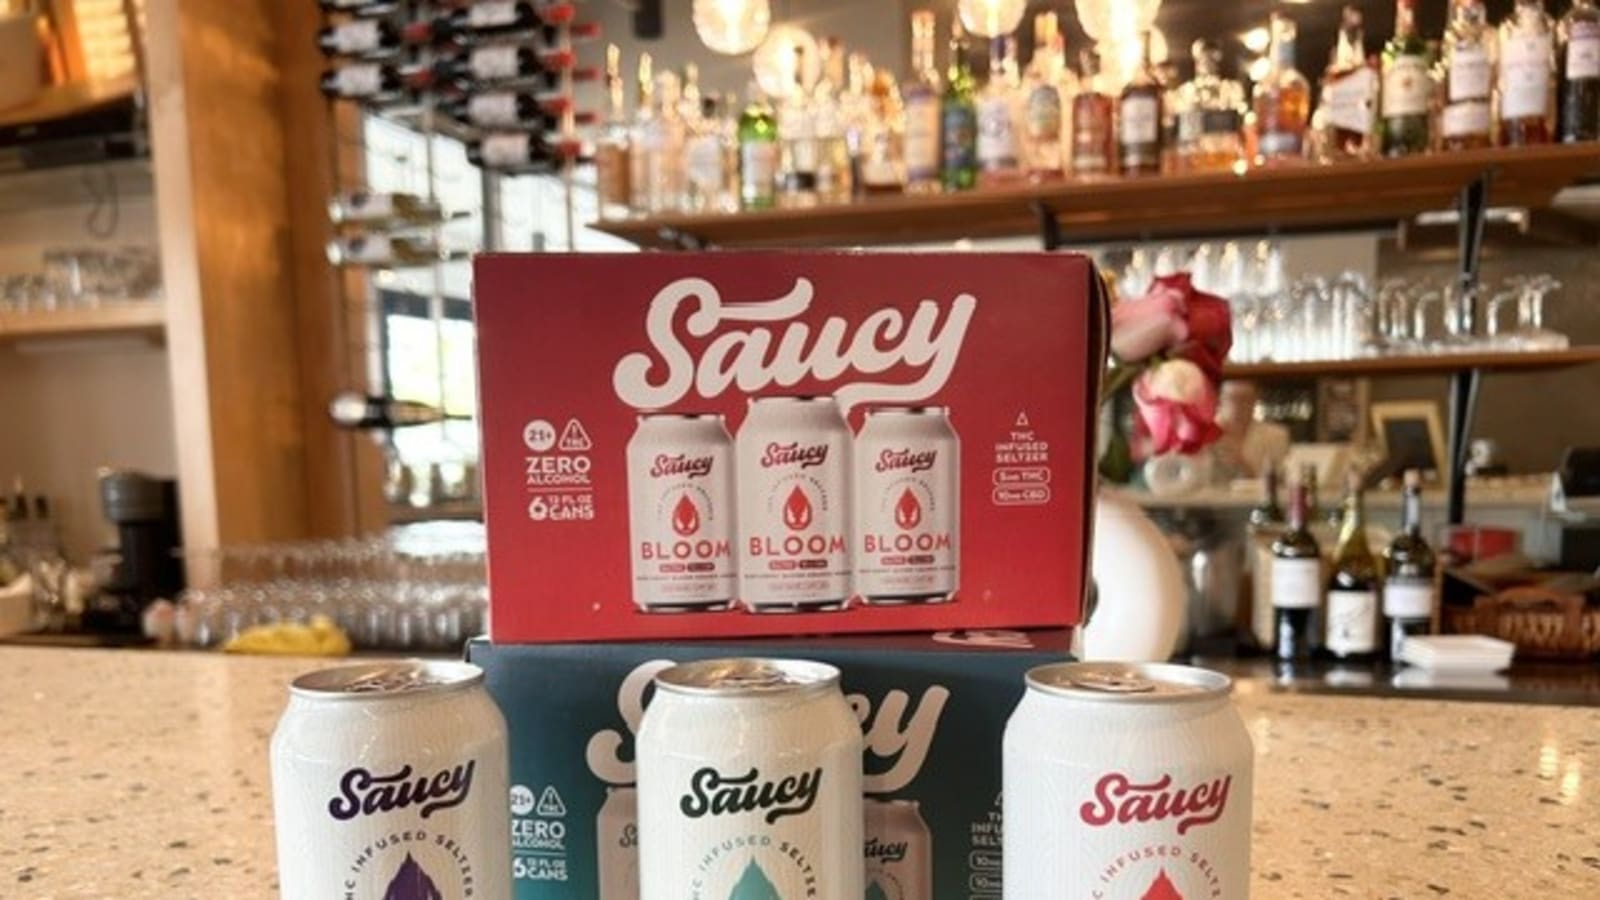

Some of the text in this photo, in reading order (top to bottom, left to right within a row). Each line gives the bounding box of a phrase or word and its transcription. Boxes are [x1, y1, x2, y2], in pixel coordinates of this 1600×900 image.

[613, 277, 977, 414] Saucy
[528, 429, 552, 441] 21+
[1010, 432, 1035, 440] THC
[759, 441, 829, 469] Saucy
[994, 441, 1048, 451] INFUSED
[525, 456, 591, 473] ZERO
[651, 453, 714, 479] Saucy
[875, 448, 938, 473] Saucy
[995, 452, 1048, 462] SELTZER
[526, 474, 591, 484] ALCOHOL
[528, 496, 548, 520] 6
[549, 504, 594, 520] CANS
[641, 541, 731, 560] BLOOM
[748, 534, 845, 556] BLOOM
[864, 533, 951, 553] BLOOM
[329, 759, 475, 820] Saucy
[680, 766, 823, 825] Saucy
[1080, 773, 1232, 835] Saucy
[511, 819, 566, 839] ZERO
[972, 823, 1003, 833] INFU
[351, 830, 427, 873] INFUSED
[434, 834, 474, 898] SELTZER
[527, 866, 568, 881] CANS
[699, 834, 771, 871] INFUSED
[779, 841, 816, 898] SELTZE
[1100, 845, 1221, 898] INFUSED SELTZ
